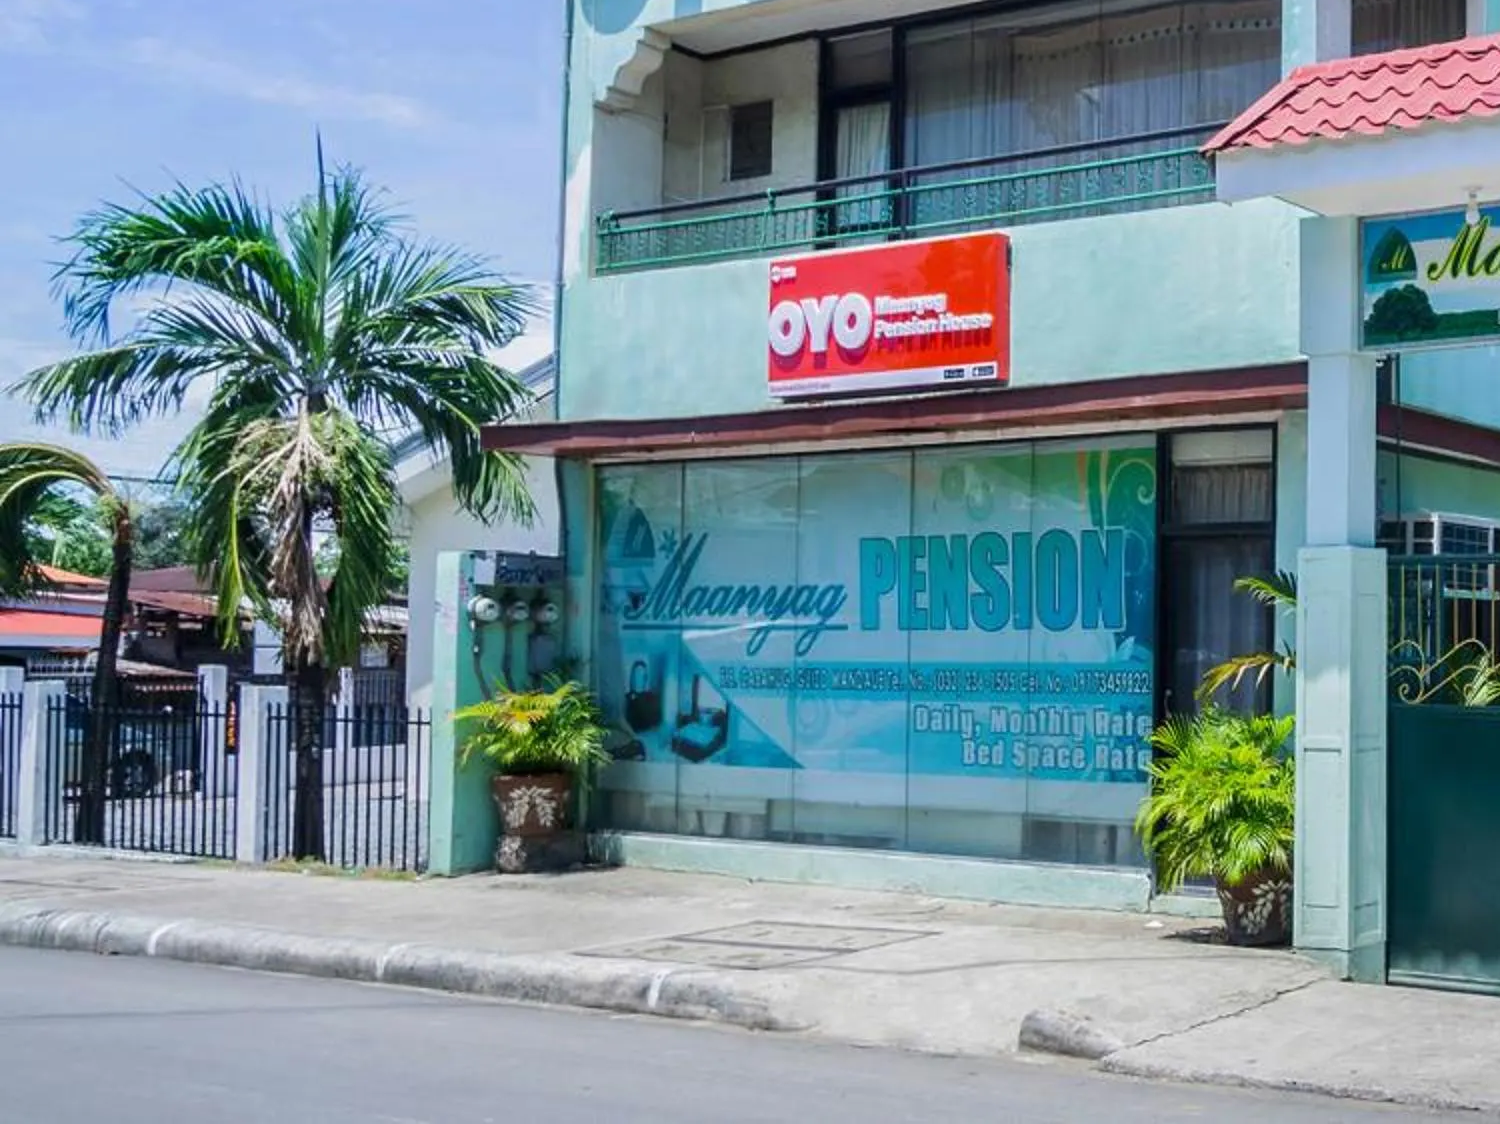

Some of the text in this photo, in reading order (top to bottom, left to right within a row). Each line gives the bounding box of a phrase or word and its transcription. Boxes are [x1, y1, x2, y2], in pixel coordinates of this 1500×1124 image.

[769, 292, 872, 356] OYO
[623, 527, 1127, 656] Maanyag PENSION
[913, 703, 981, 740] Daily,
[989, 705, 1086, 740] Monthly
[962, 739, 1005, 766] Bed
[1012, 740, 1087, 772] Space
